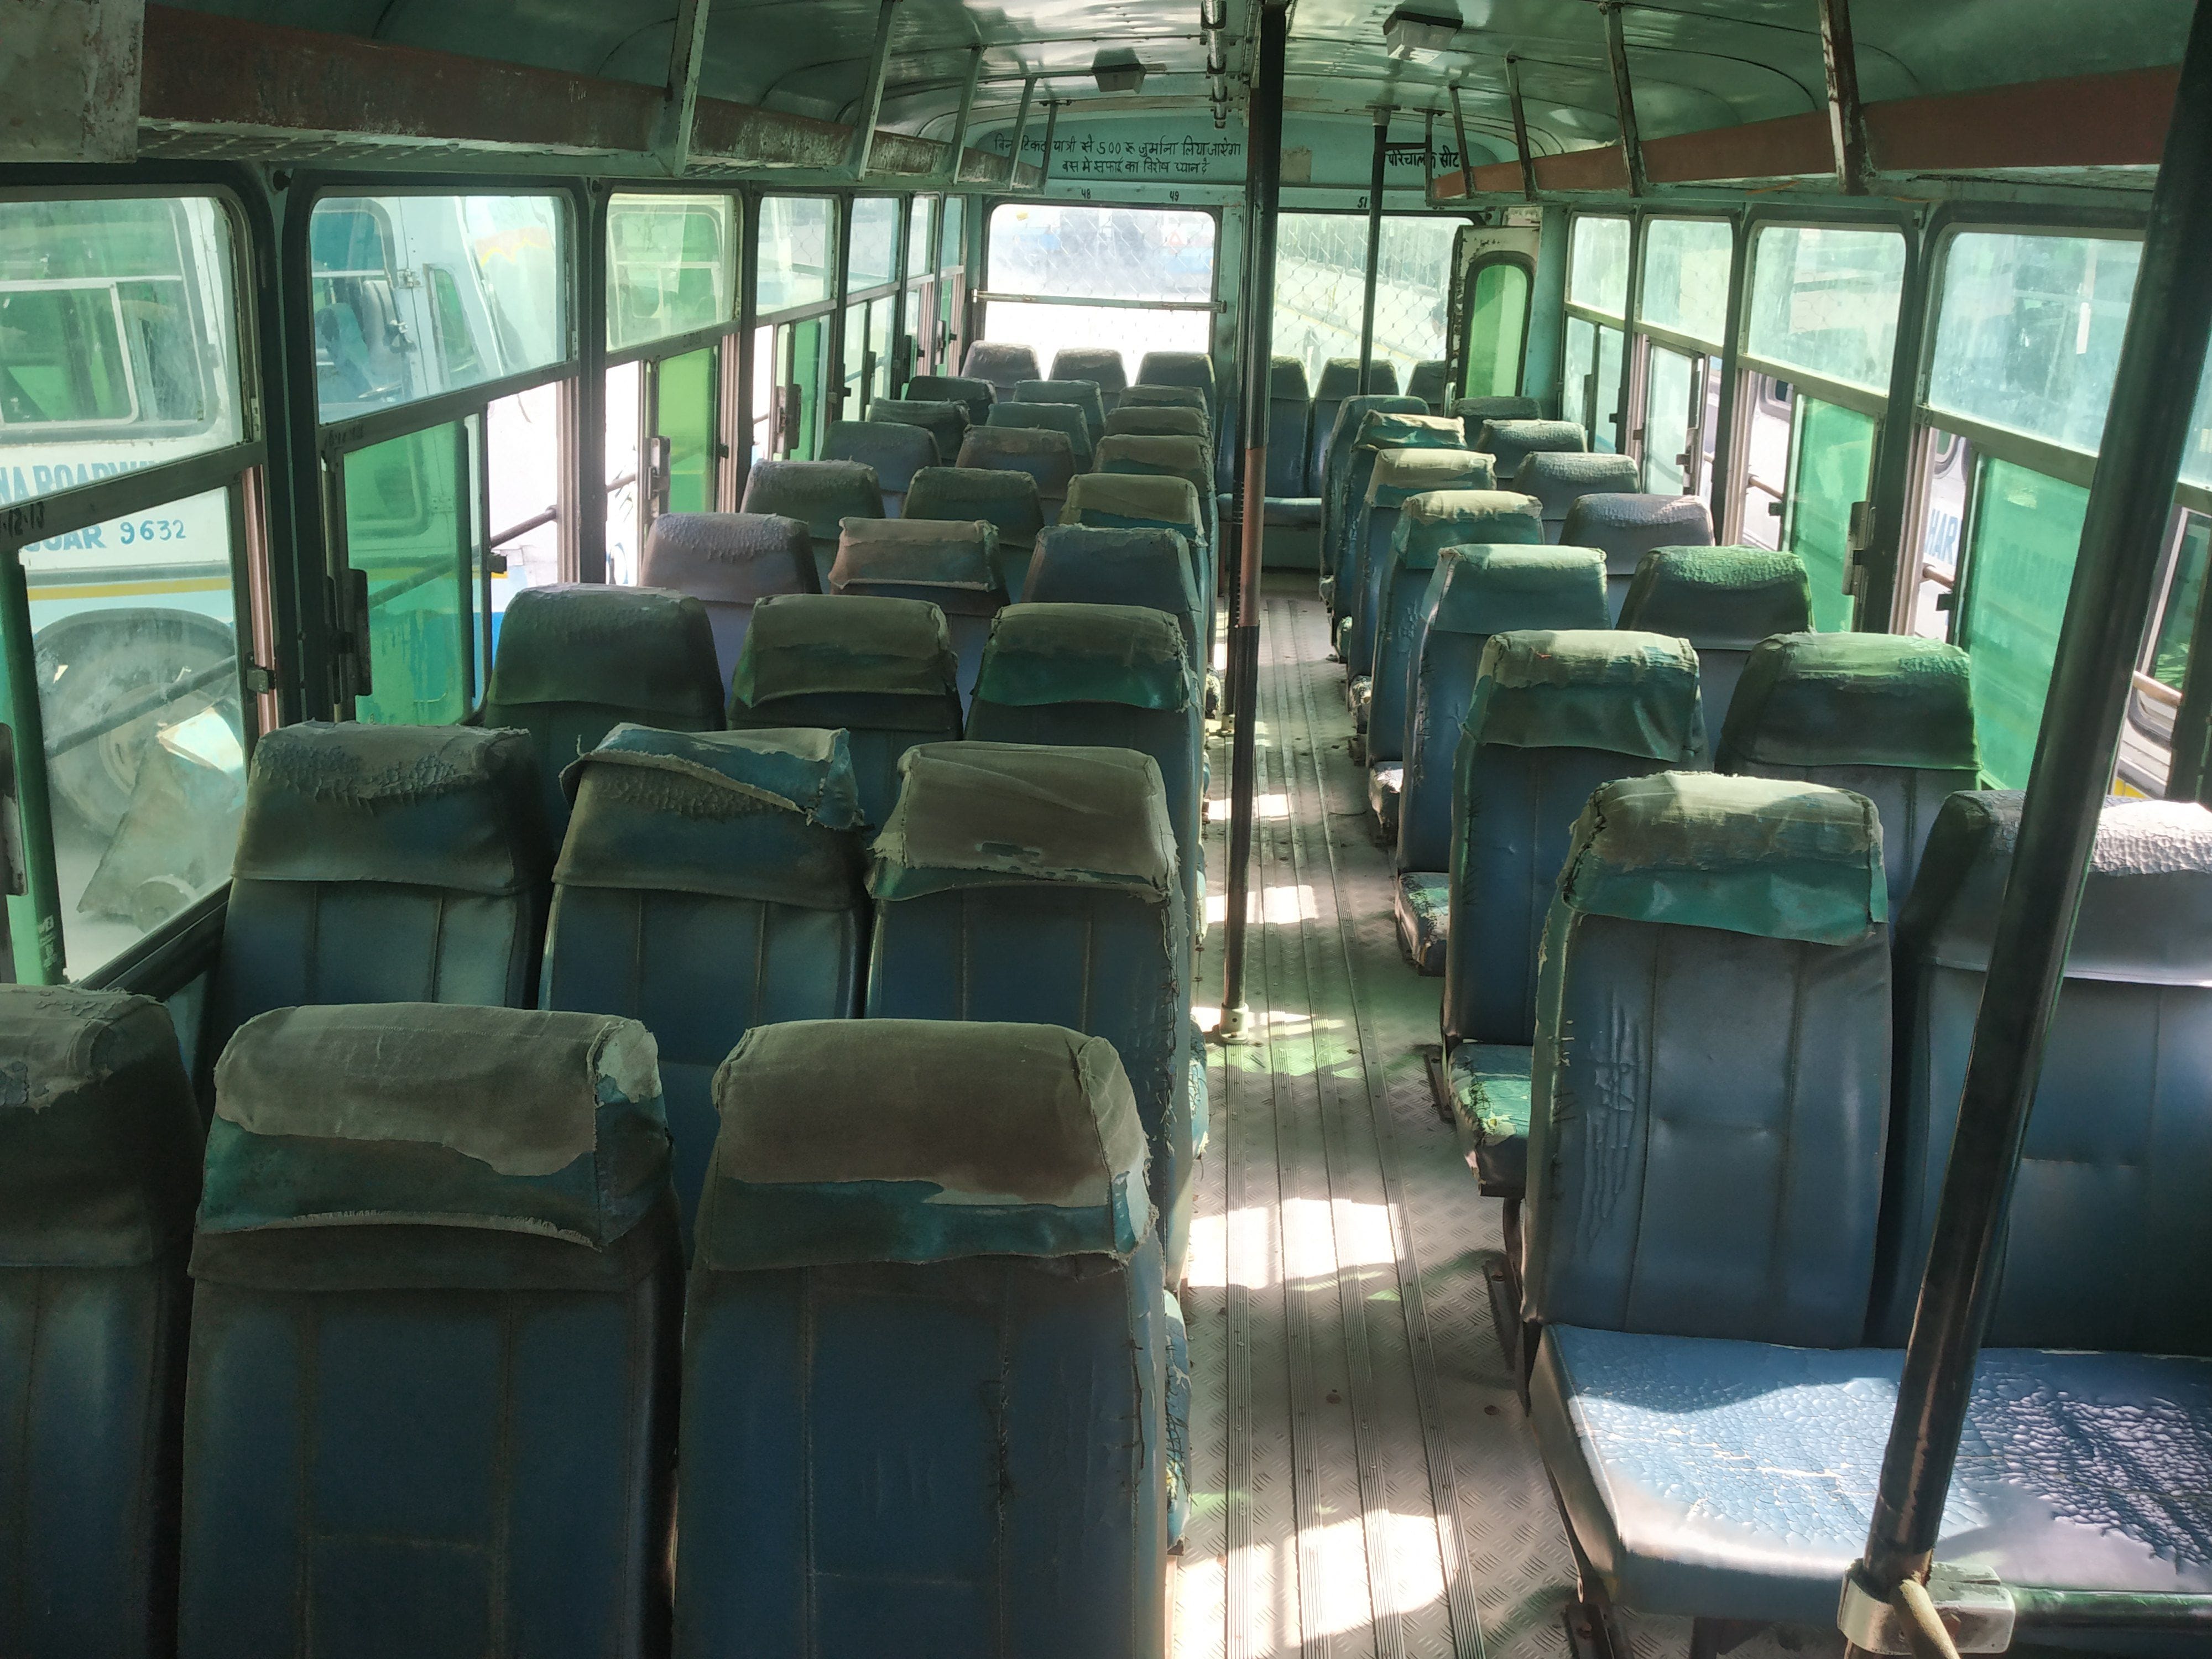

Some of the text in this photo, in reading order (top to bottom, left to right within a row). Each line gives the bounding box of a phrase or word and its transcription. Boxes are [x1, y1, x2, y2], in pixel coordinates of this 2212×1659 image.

[1053, 135, 1077, 153] यात्री
[1080, 134, 1095, 153] से
[1097, 142, 1121, 154] 500
[1181, 135, 1211, 156] लिया
[1439, 144, 1460, 168] सीट
[1125, 160, 1140, 173] का
[1081, 188, 1092, 200] 48
[1170, 190, 1180, 202] 49
[1357, 196, 1368, 208] 51
[119, 519, 187, 545] 9632
